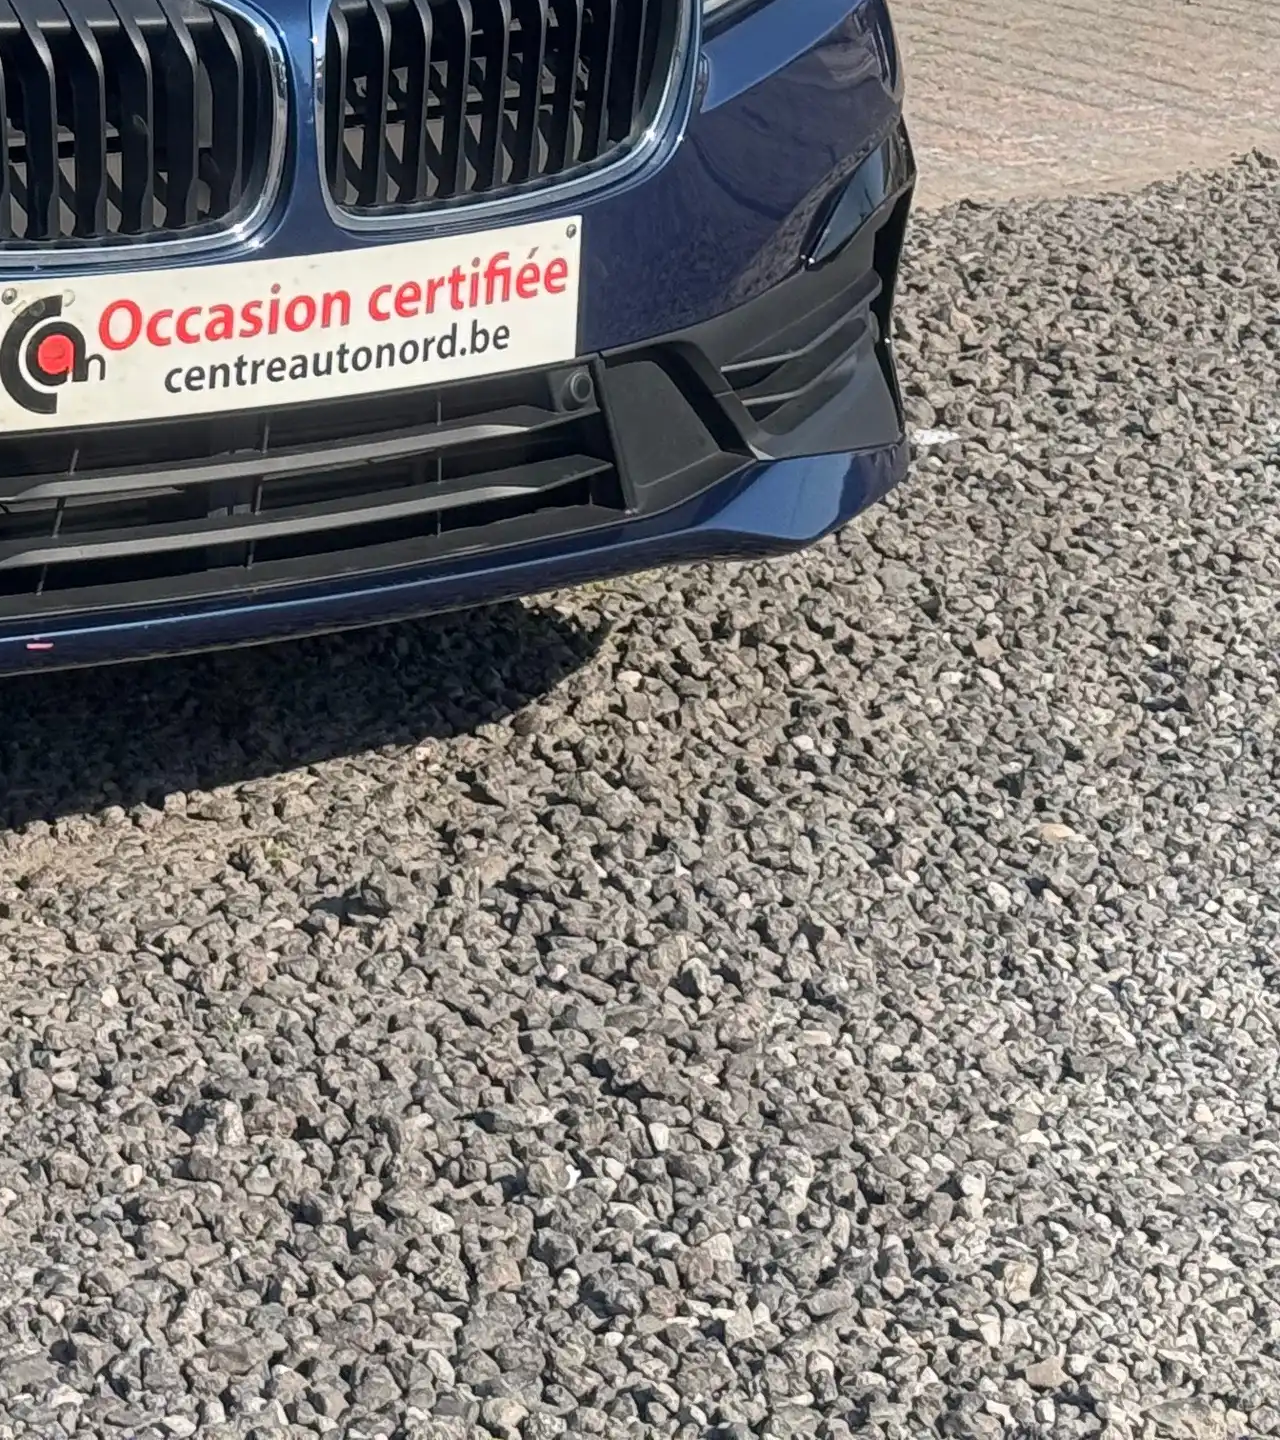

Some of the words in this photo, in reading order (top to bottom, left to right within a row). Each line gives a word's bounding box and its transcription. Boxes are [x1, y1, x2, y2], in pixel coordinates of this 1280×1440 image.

[97, 283, 352, 352] Occasion
[367, 246, 569, 322] certifiée
[164, 319, 510, 393] centreautonord.be
